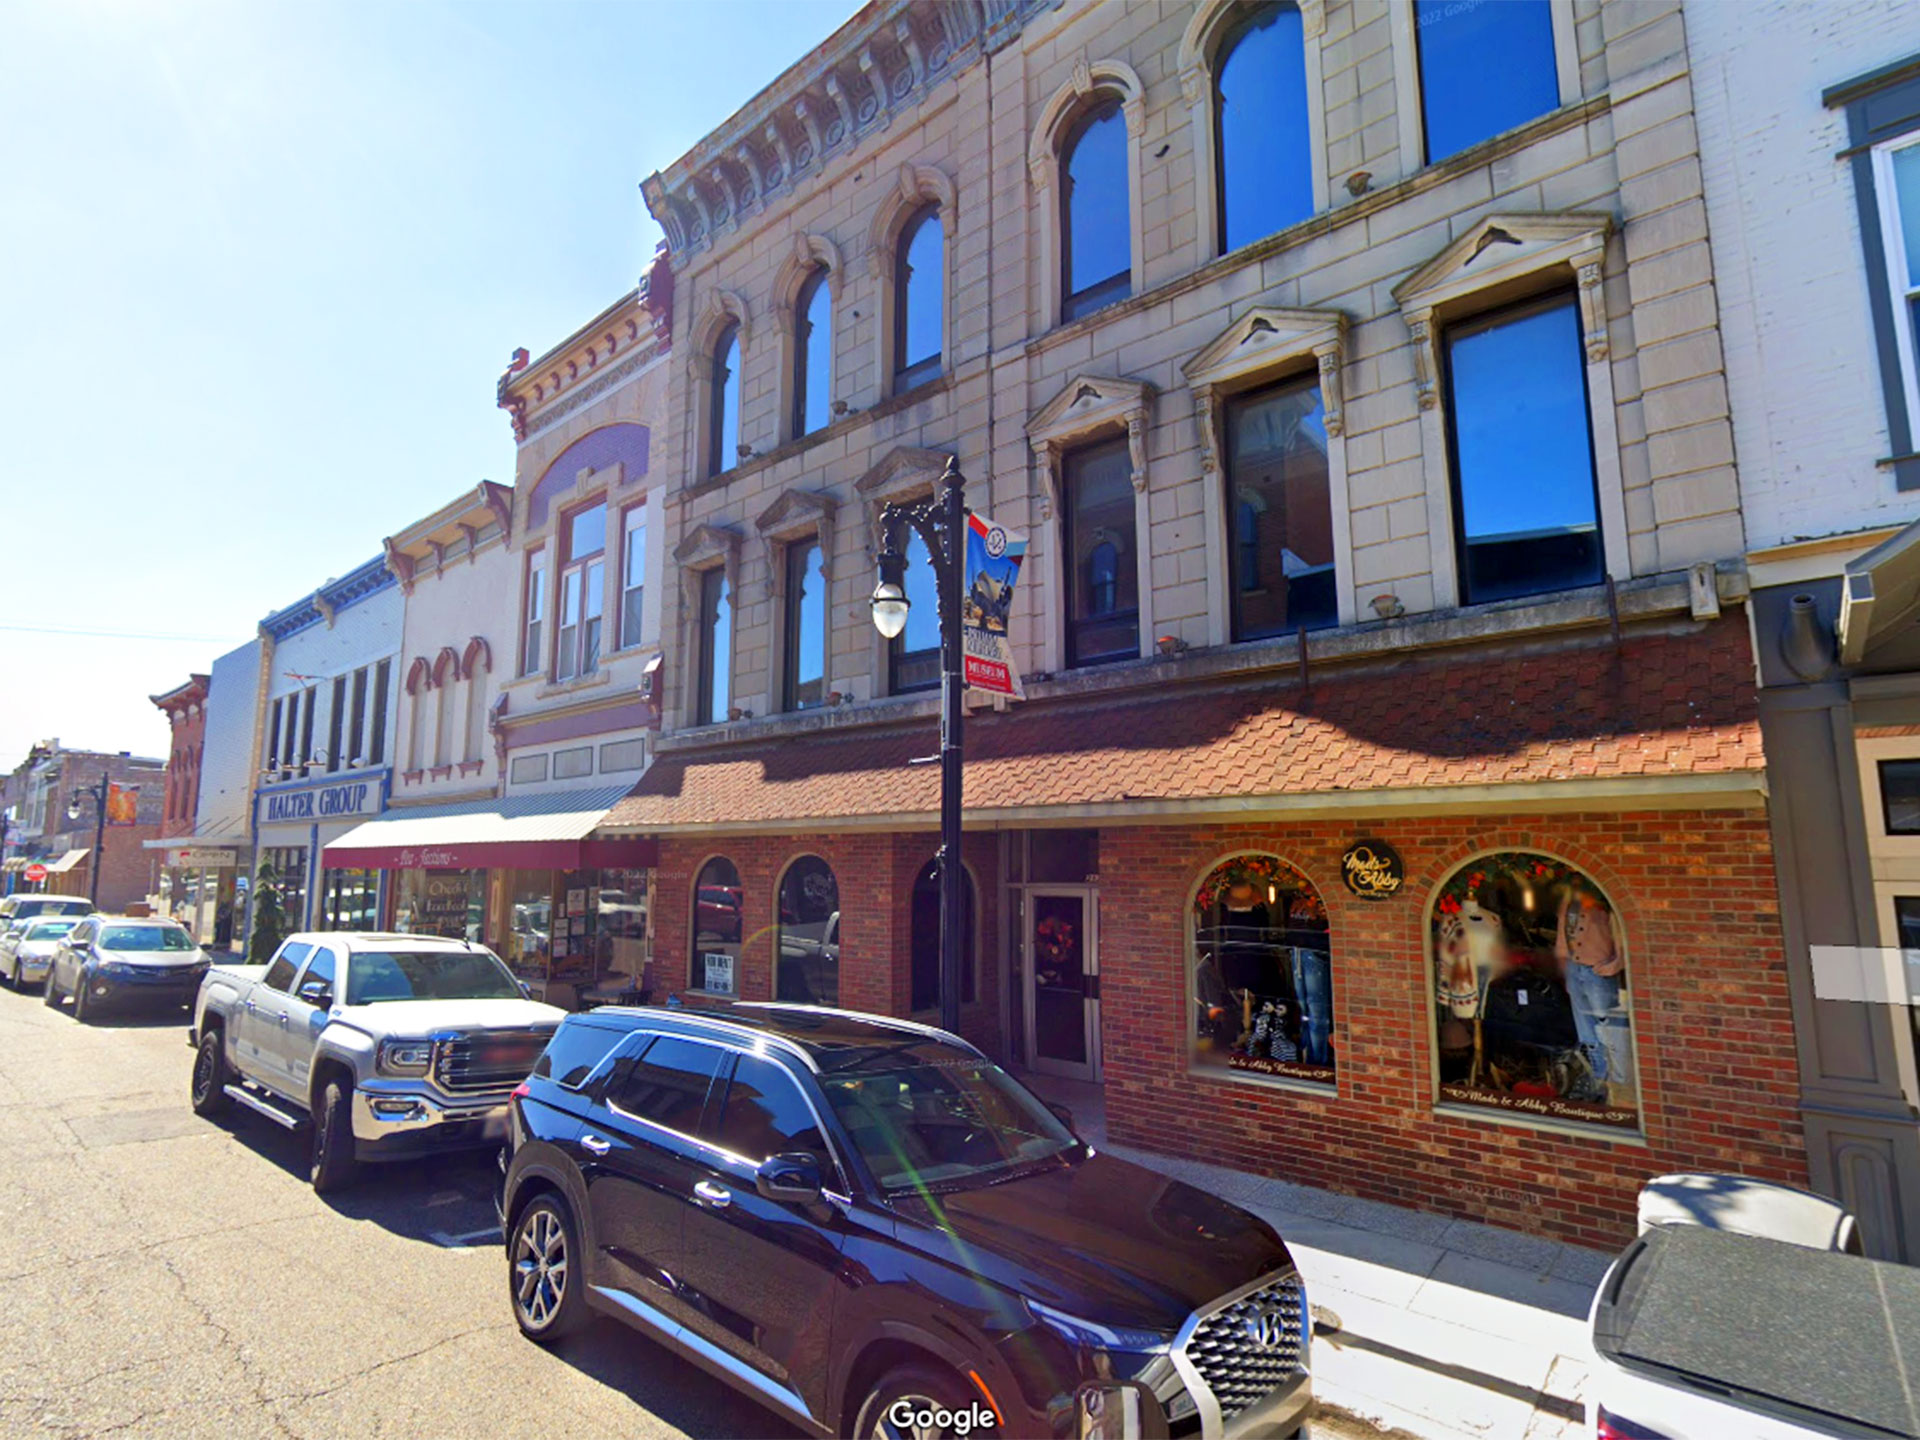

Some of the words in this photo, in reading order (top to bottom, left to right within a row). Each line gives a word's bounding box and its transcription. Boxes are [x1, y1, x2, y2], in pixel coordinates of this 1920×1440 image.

[268, 792, 314, 821] HALTER
[319, 784, 367, 816] GROUP
[1358, 870, 1401, 891] Abby
[1248, 1060, 1272, 1073] Abby
[1273, 1062, 1312, 1078] Boutique
[1514, 1097, 1548, 1113] Abby
[1550, 1101, 1603, 1120] Boutique
